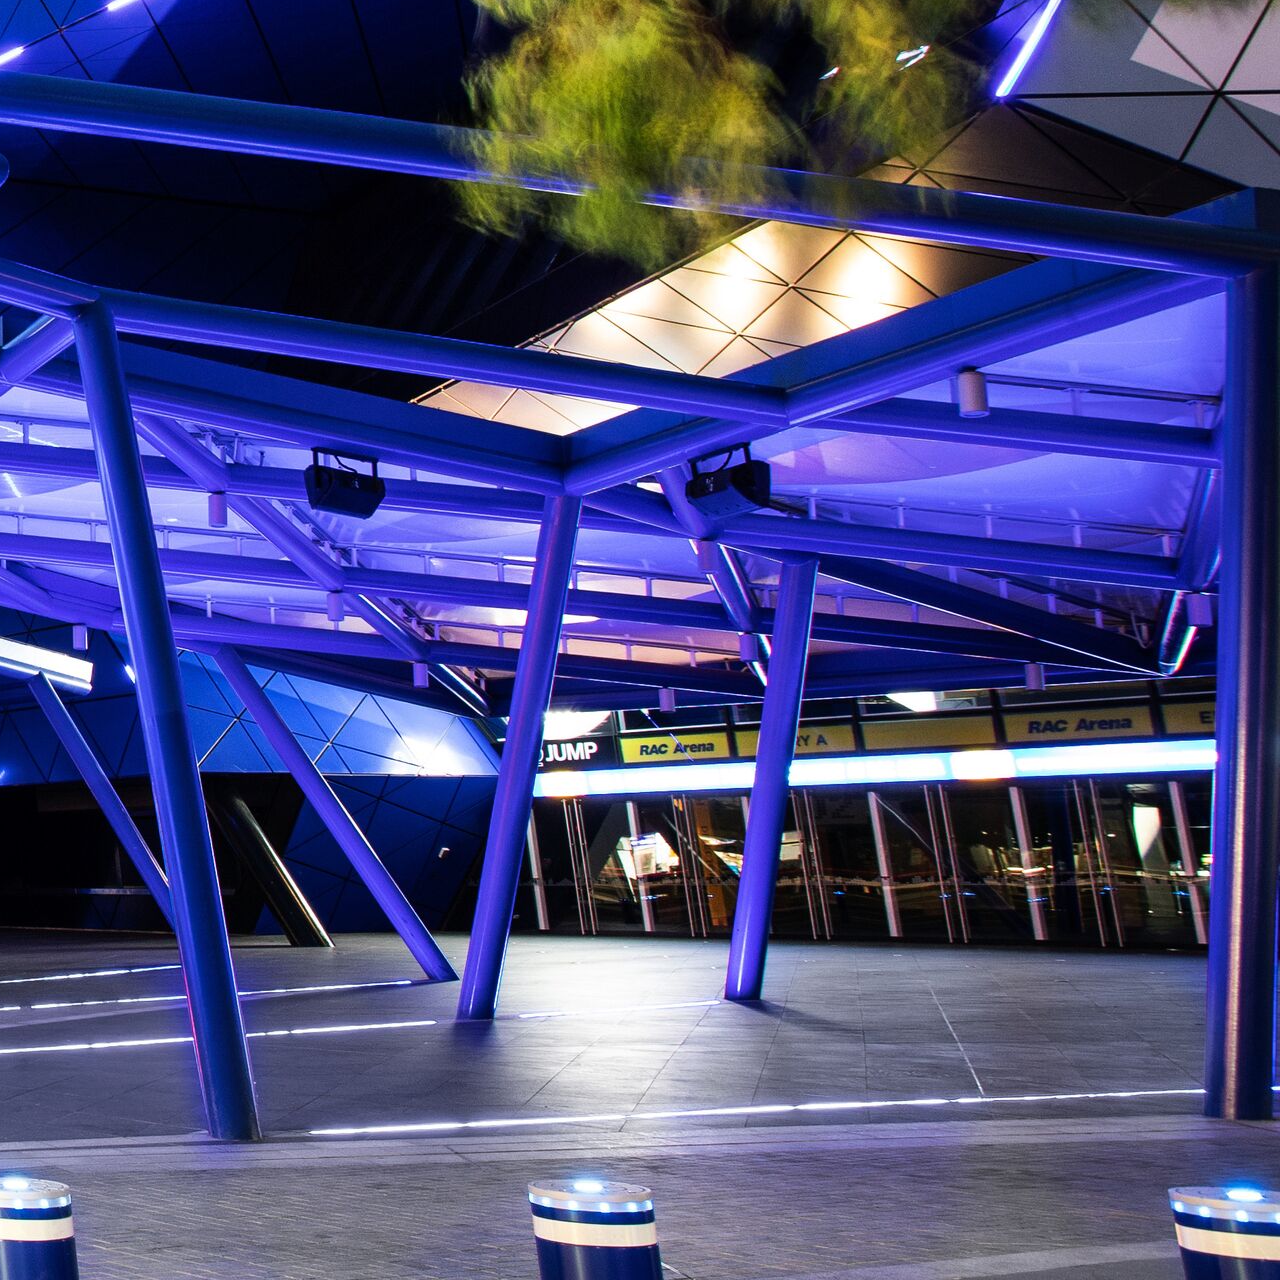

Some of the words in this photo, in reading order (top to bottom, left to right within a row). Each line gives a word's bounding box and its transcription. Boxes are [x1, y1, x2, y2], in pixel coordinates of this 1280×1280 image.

[1028, 720, 1068, 734] RAC
[1075, 716, 1132, 732] Arena
[640, 742, 668, 756] RAC
[673, 740, 715, 755] Arena
[816, 734, 828, 746] A
[545, 741, 598, 762] JUMP
